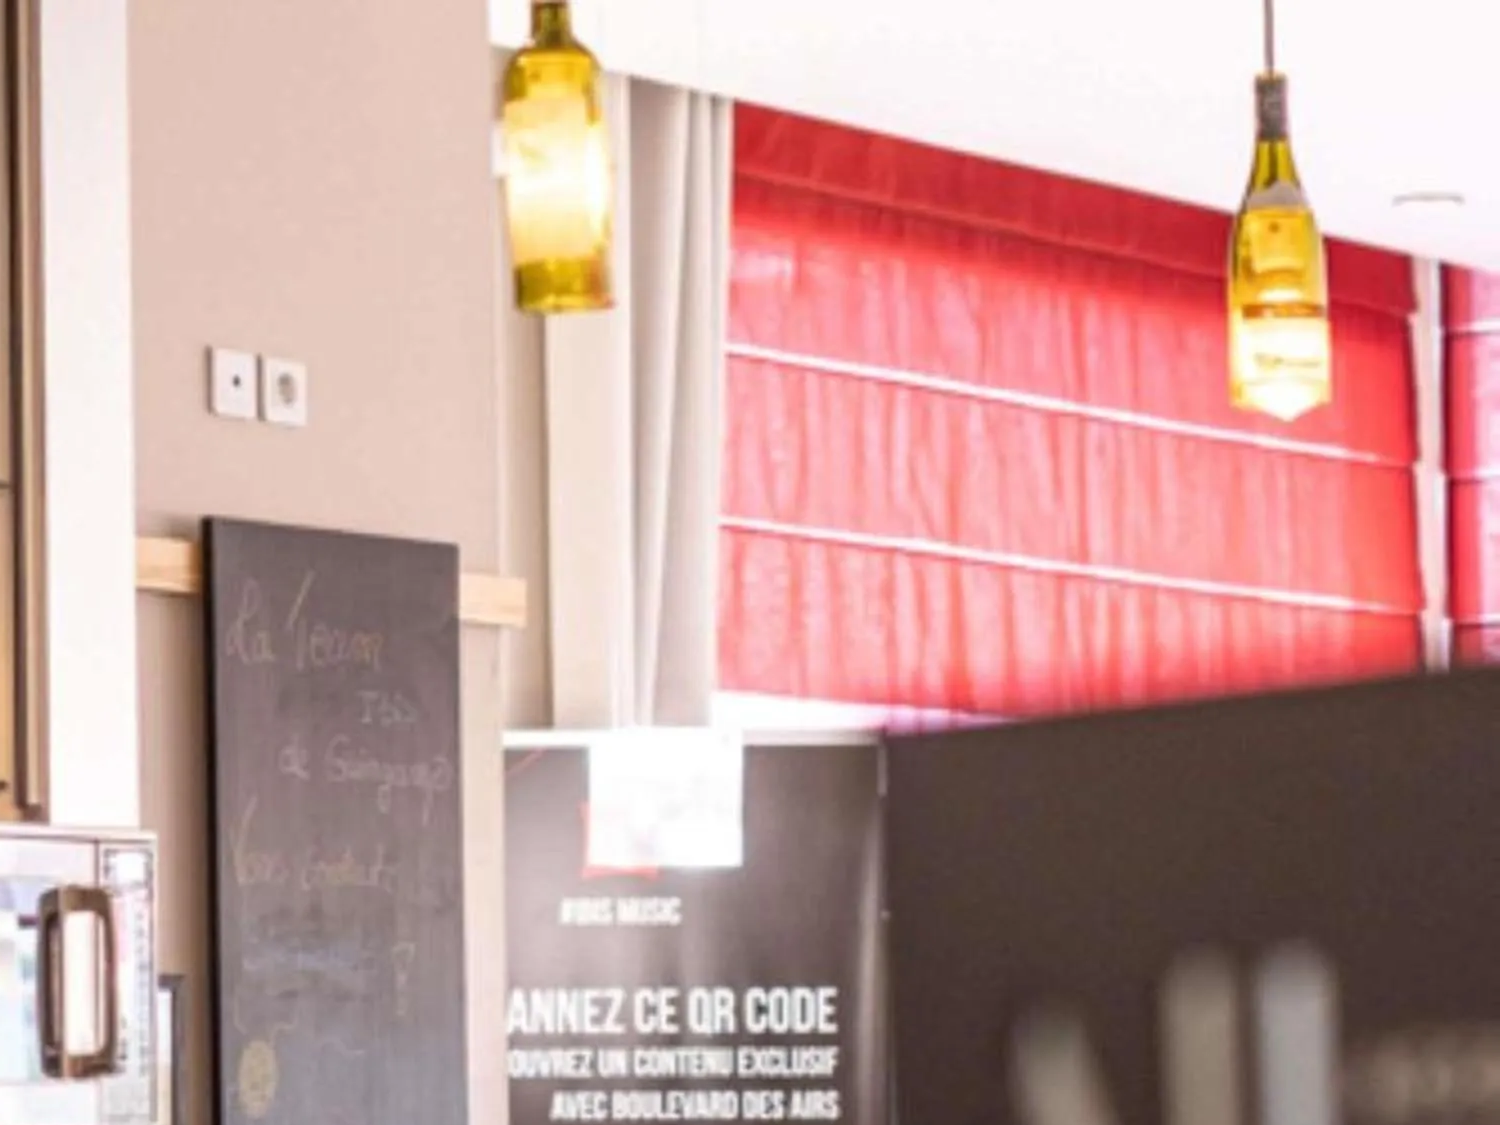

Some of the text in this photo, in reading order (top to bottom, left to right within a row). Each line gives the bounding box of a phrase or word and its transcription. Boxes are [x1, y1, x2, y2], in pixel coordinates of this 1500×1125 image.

[506, 986, 839, 1036] ANNEZ CE QR CODE
[598, 1046, 629, 1077] UN
[634, 1046, 734, 1077] CONTENU
[737, 1046, 839, 1077] EXCLUSIF
[551, 1090, 841, 1121] AVEC BOULEVARD DES AIRS
